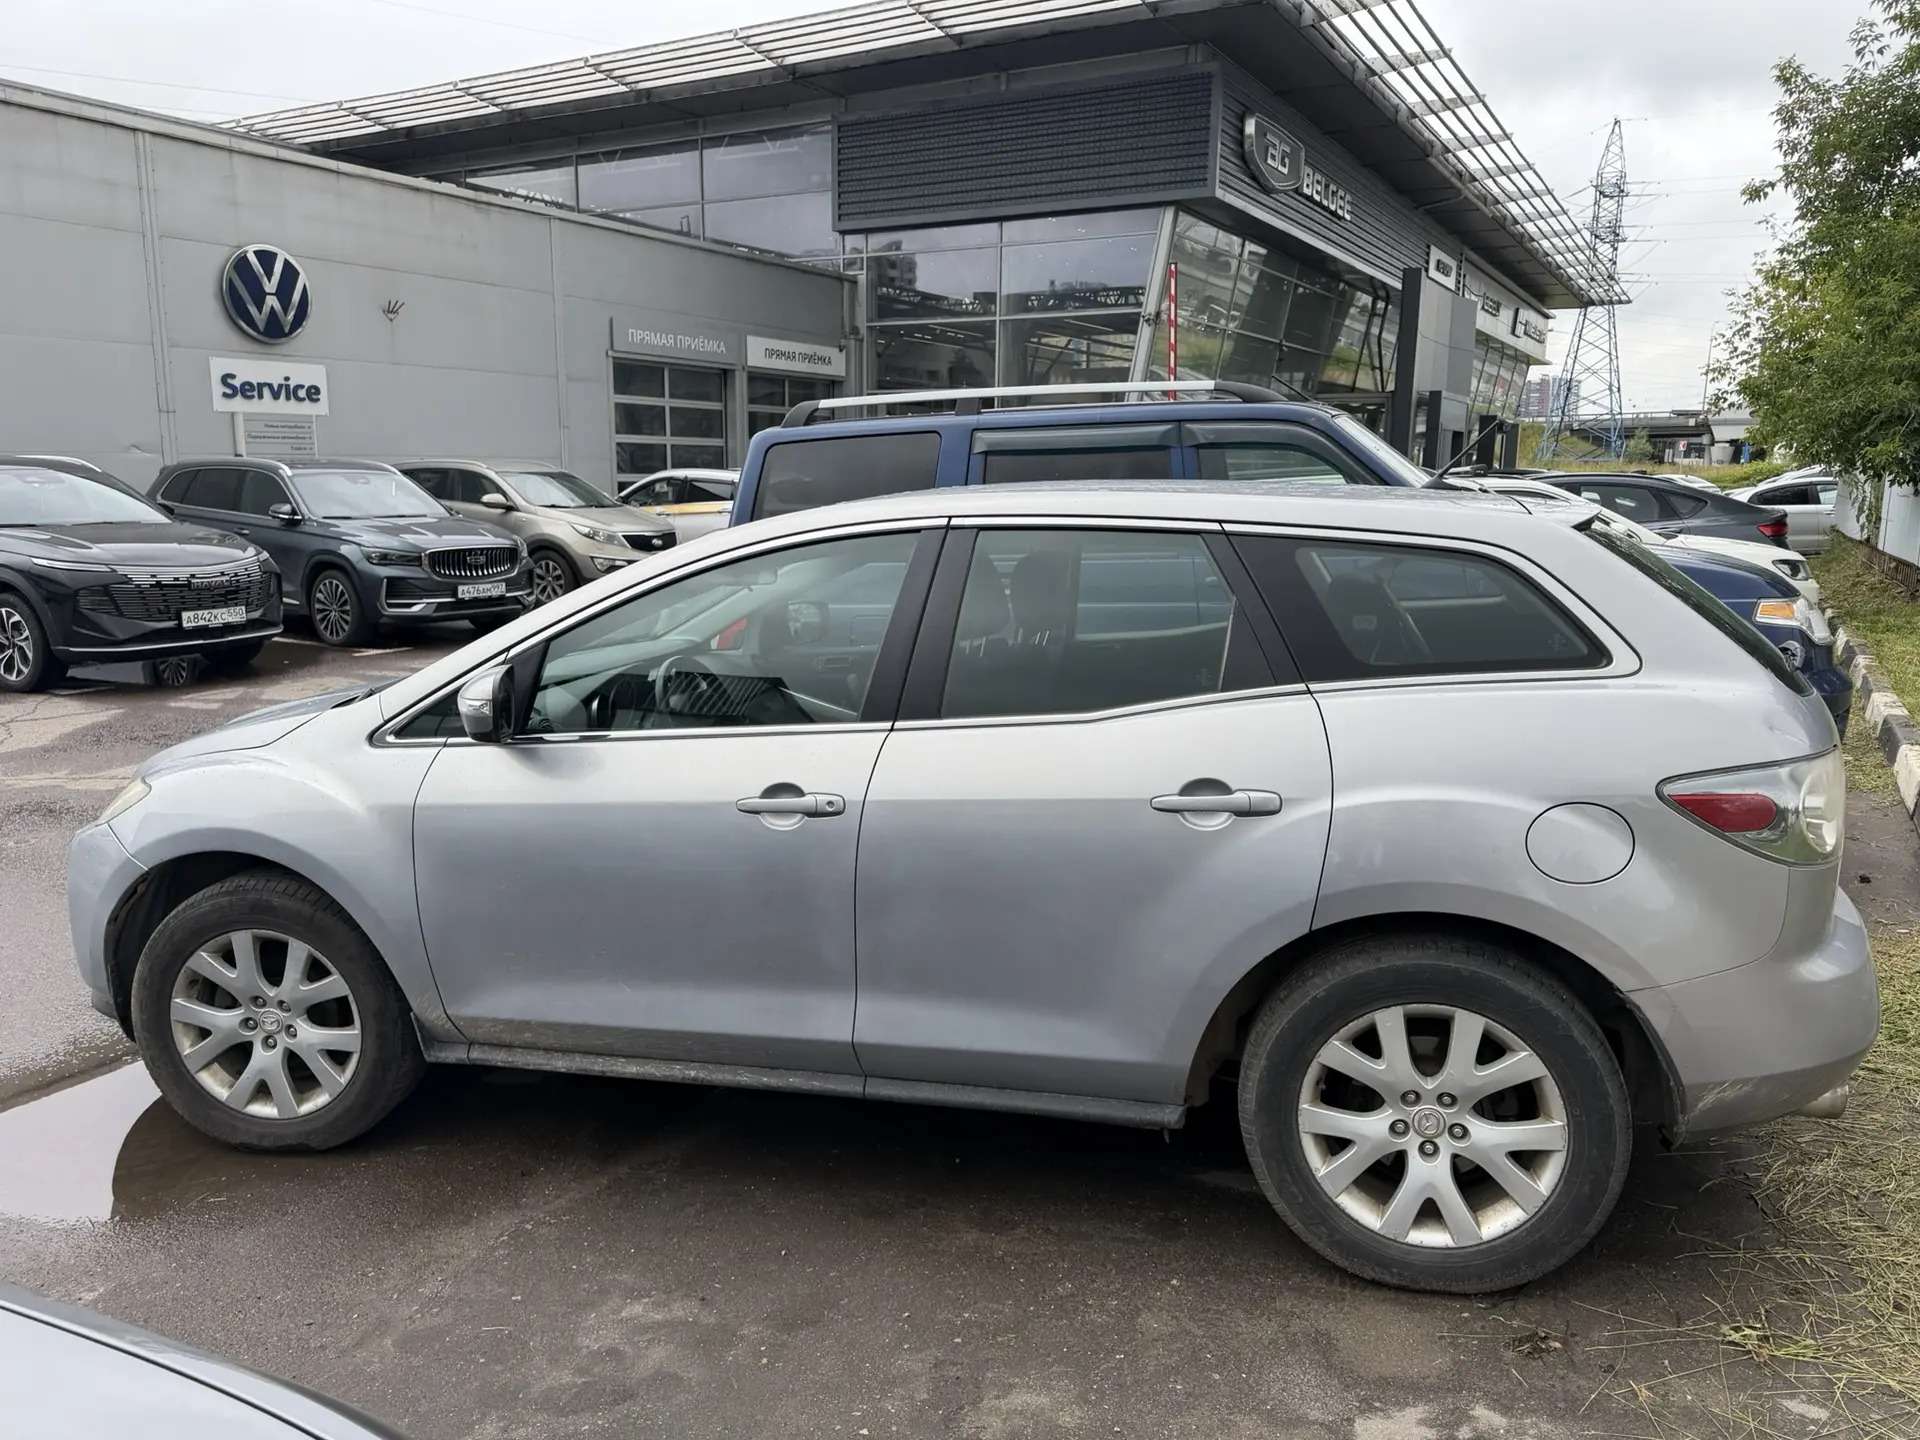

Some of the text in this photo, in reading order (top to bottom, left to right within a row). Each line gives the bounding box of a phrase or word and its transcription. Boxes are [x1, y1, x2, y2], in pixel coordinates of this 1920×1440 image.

[628, 328, 727, 354] ПРЯМАЯ ПРИЁМКА
[764, 347, 832, 366] ПРЯМАЯ ПРИЁМКА
[220, 372, 321, 403] Service
